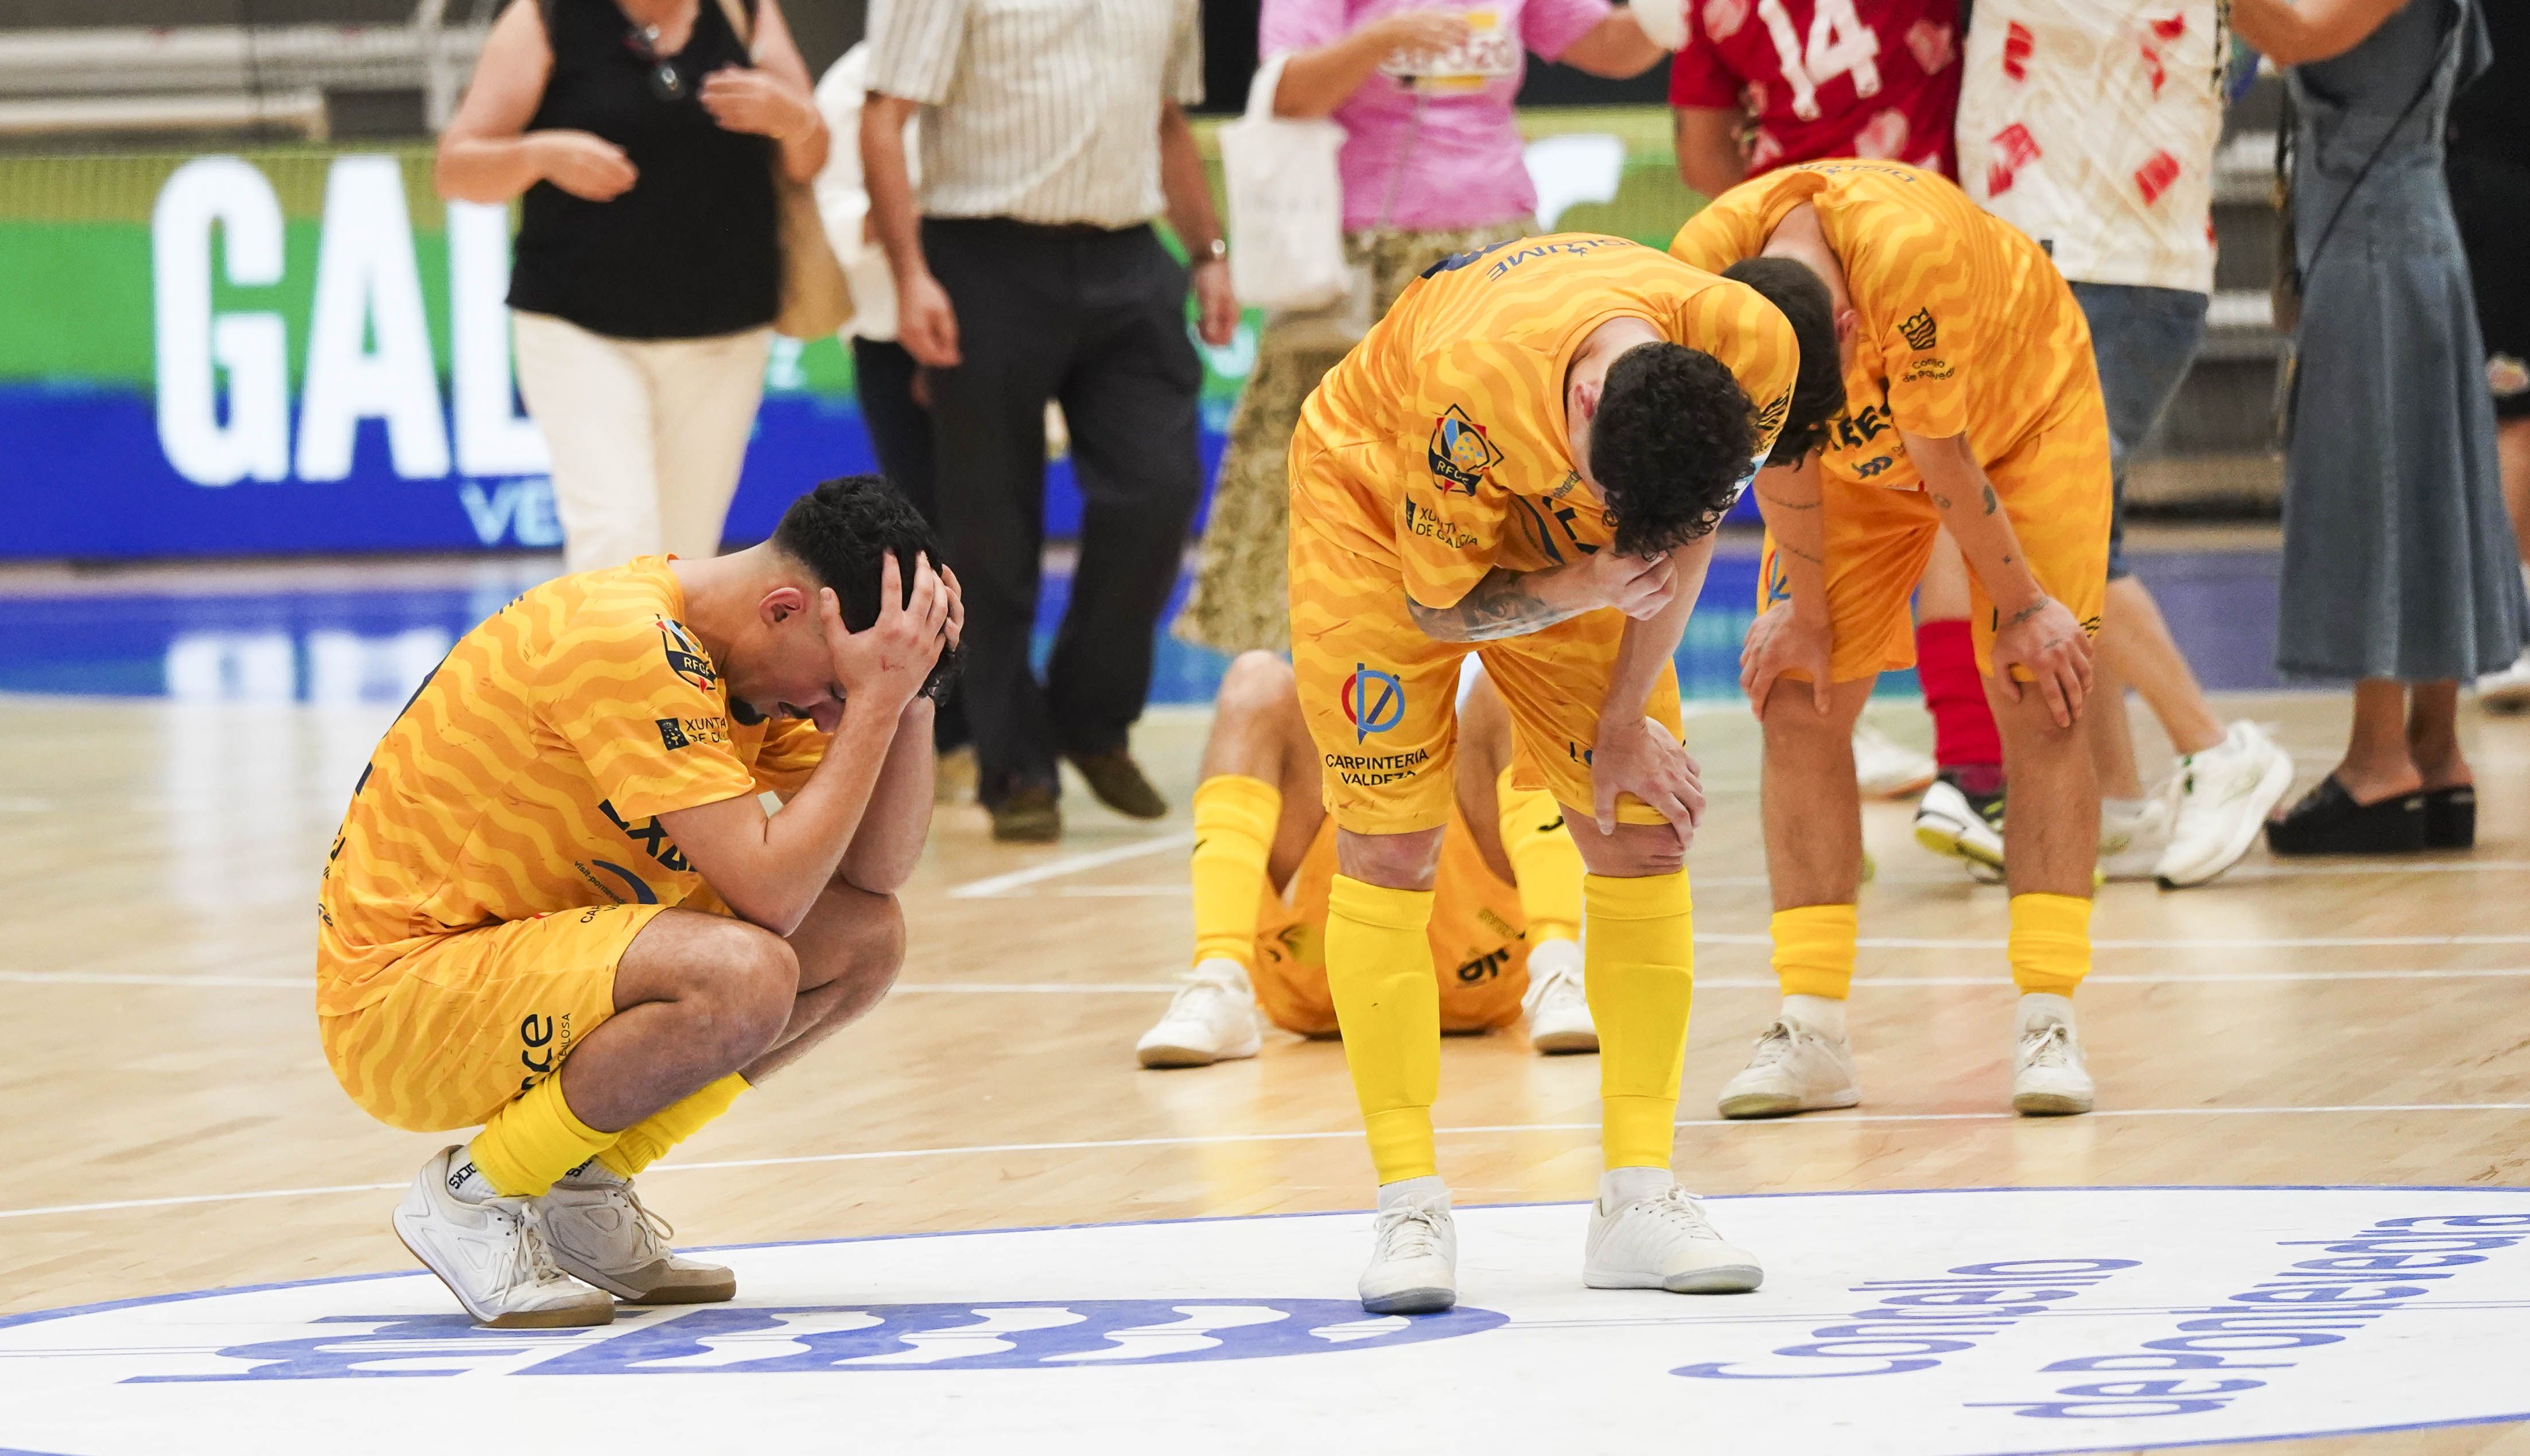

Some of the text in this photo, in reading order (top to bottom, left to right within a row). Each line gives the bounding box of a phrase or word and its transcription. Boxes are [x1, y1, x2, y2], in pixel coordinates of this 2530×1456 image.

[1416, 523, 1432, 536] DE
[685, 717, 726, 731] XUNTA
[1668, 1258, 2143, 1379] Concello
